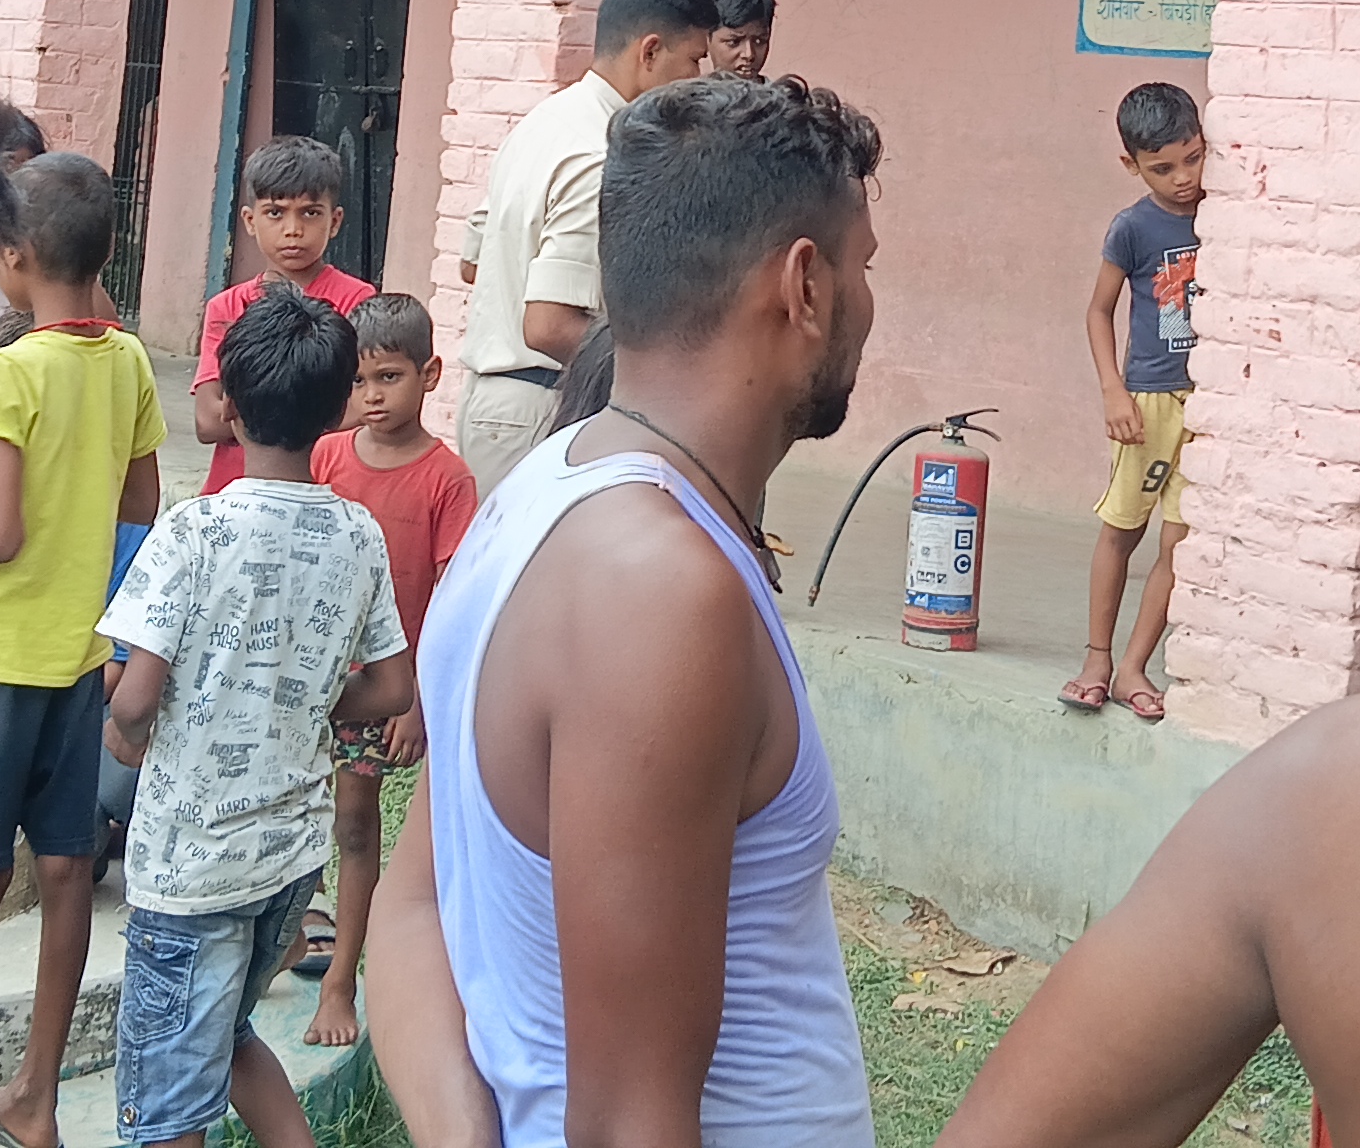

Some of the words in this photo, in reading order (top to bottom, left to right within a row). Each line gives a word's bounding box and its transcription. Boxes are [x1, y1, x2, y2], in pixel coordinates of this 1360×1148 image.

[1141, 459, 1170, 494] 9
[215, 796, 251, 817] HARD
[184, 841, 211, 862] FUN
